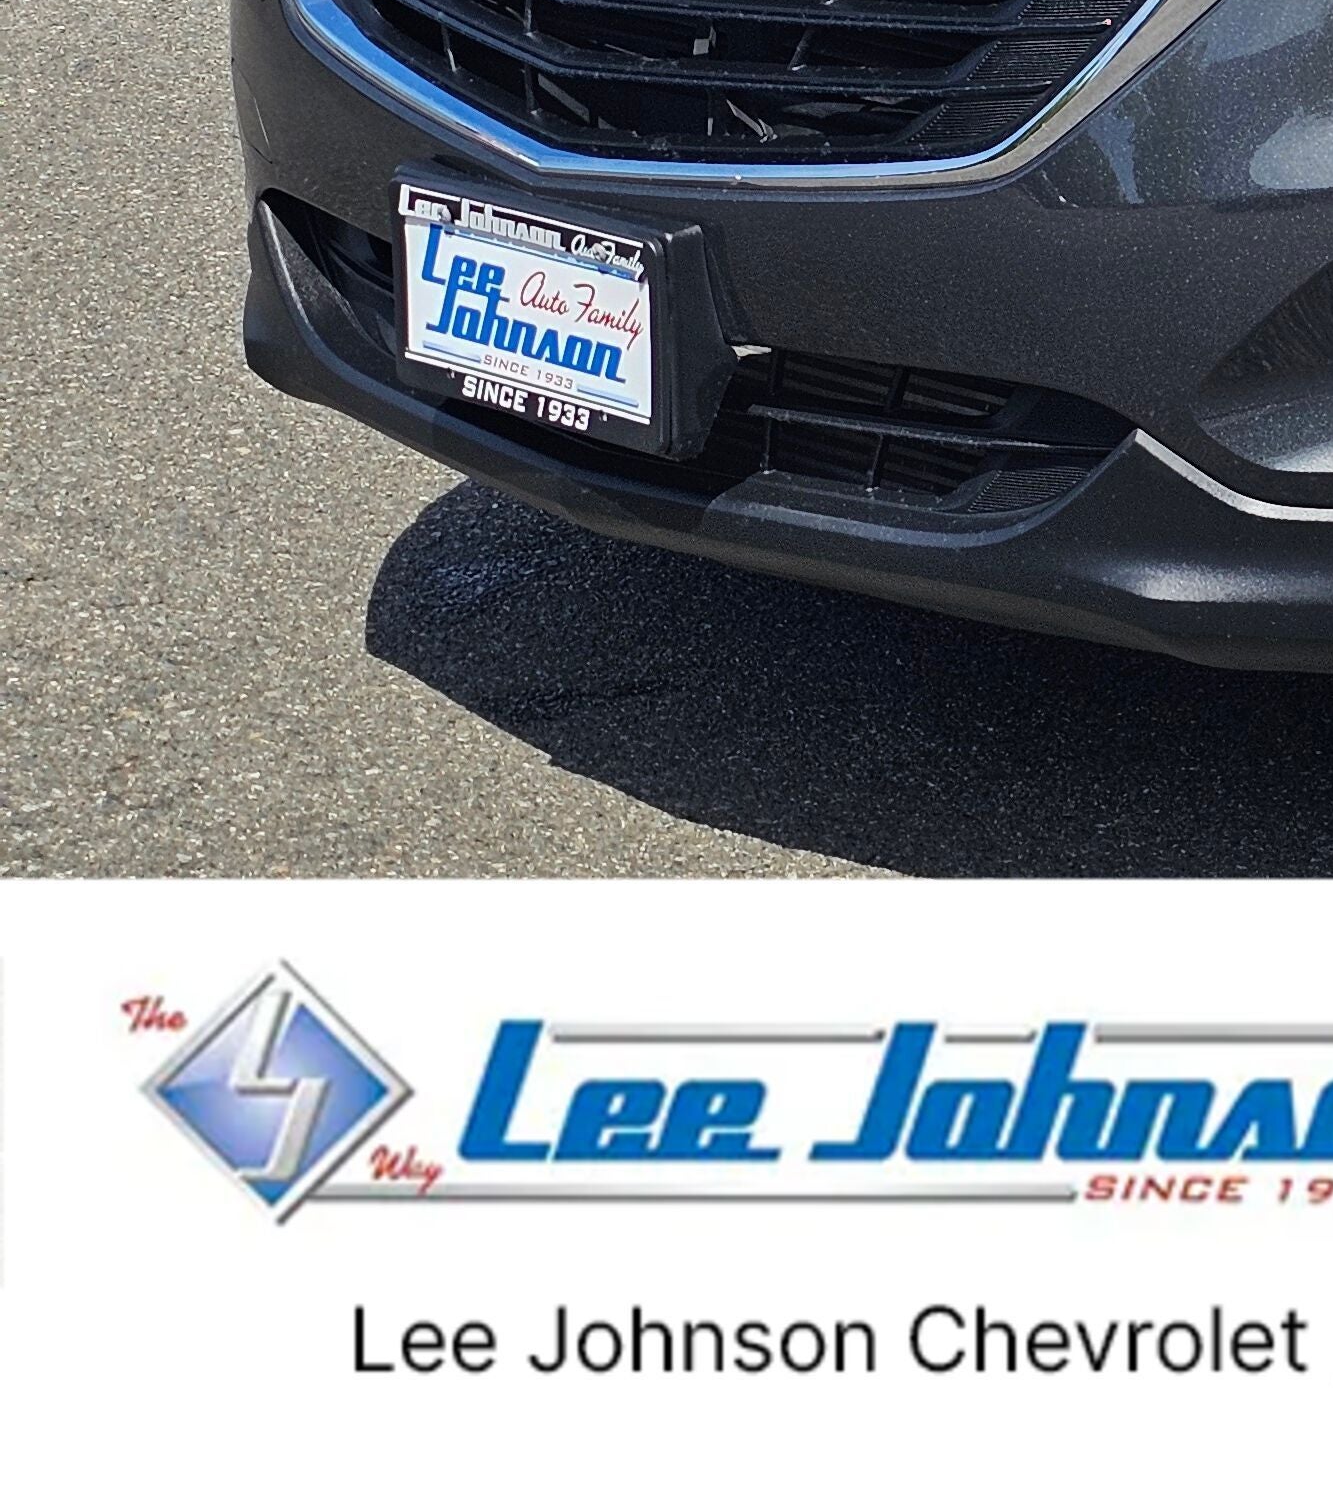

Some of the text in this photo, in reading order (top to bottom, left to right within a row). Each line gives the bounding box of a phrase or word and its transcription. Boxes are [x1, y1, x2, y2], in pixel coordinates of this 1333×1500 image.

[421, 223, 510, 302] Lee
[454, 198, 567, 252] Johnson
[571, 234, 601, 260] Aut
[426, 283, 626, 384] Johnson
[520, 271, 644, 350] Auto Family
[461, 376, 591, 431] SINCE 1933
[483, 355, 575, 390] SINCE 1933
